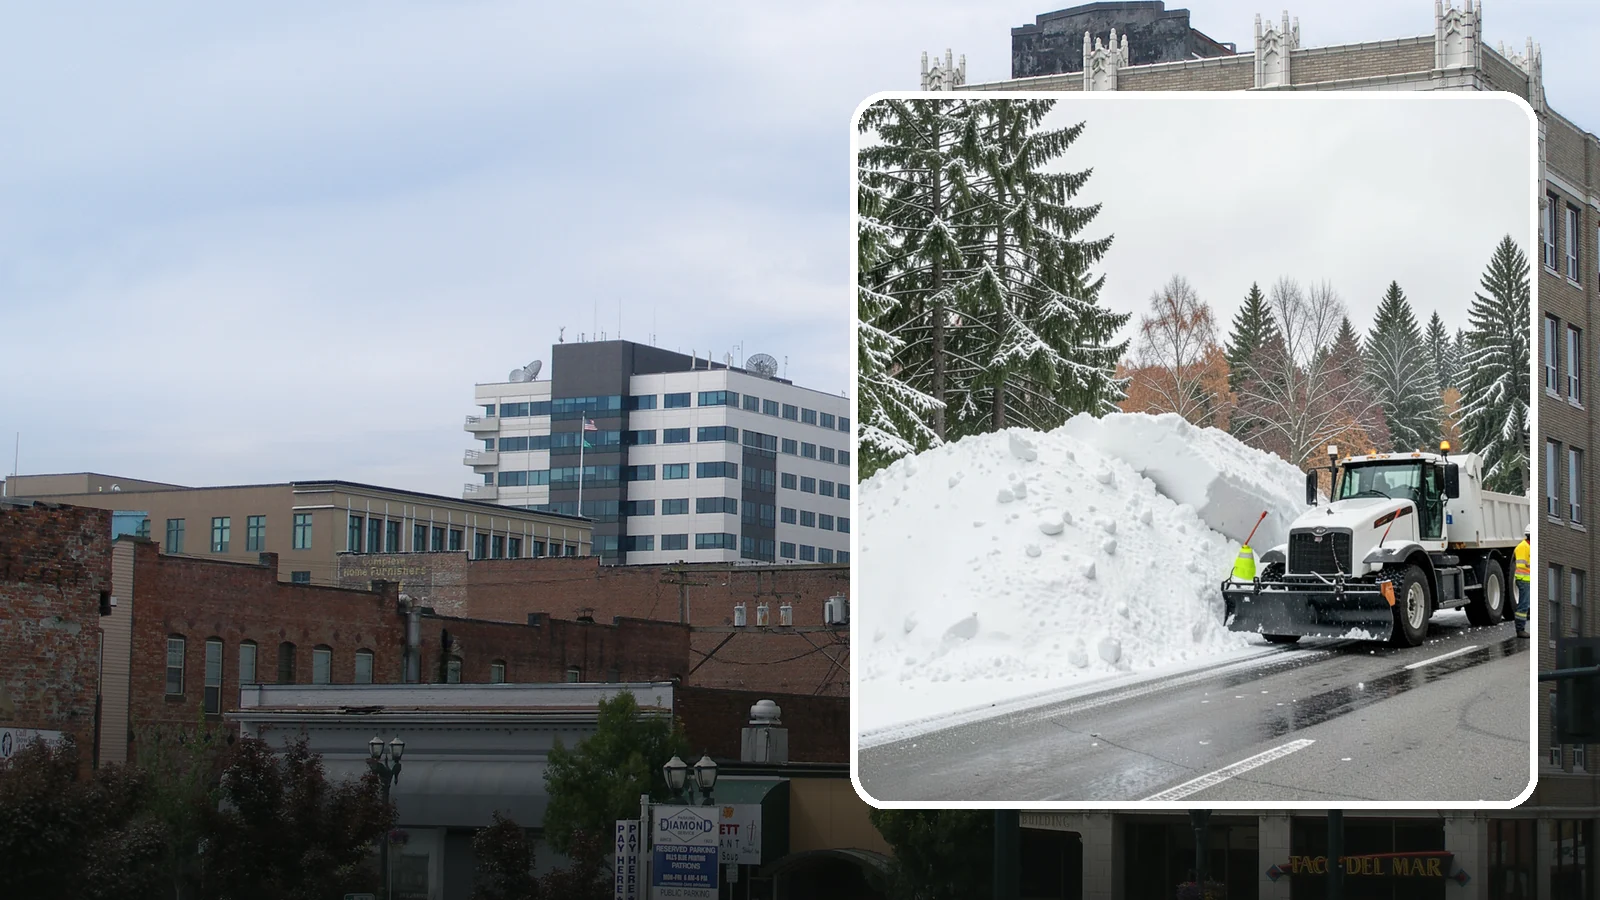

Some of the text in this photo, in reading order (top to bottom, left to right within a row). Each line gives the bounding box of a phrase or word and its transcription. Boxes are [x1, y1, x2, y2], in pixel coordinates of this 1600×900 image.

[343, 566, 427, 577] Home Furnishers
[660, 818, 713, 832] DIAMOND
[1022, 815, 1070, 828] BUILDING
[719, 823, 740, 835] ETT
[655, 845, 716, 854] RESERVED PARKING
[719, 838, 740, 849] ANT
[616, 824, 625, 894] PAY HERE
[627, 824, 637, 893] PAY HERE
[721, 851, 739, 863] Soup
[671, 861, 701, 870] PATRONS
[1345, 855, 1385, 876] DEL
[1392, 857, 1443, 877] MAR
[660, 888, 710, 898] PUBLIC PARKING
